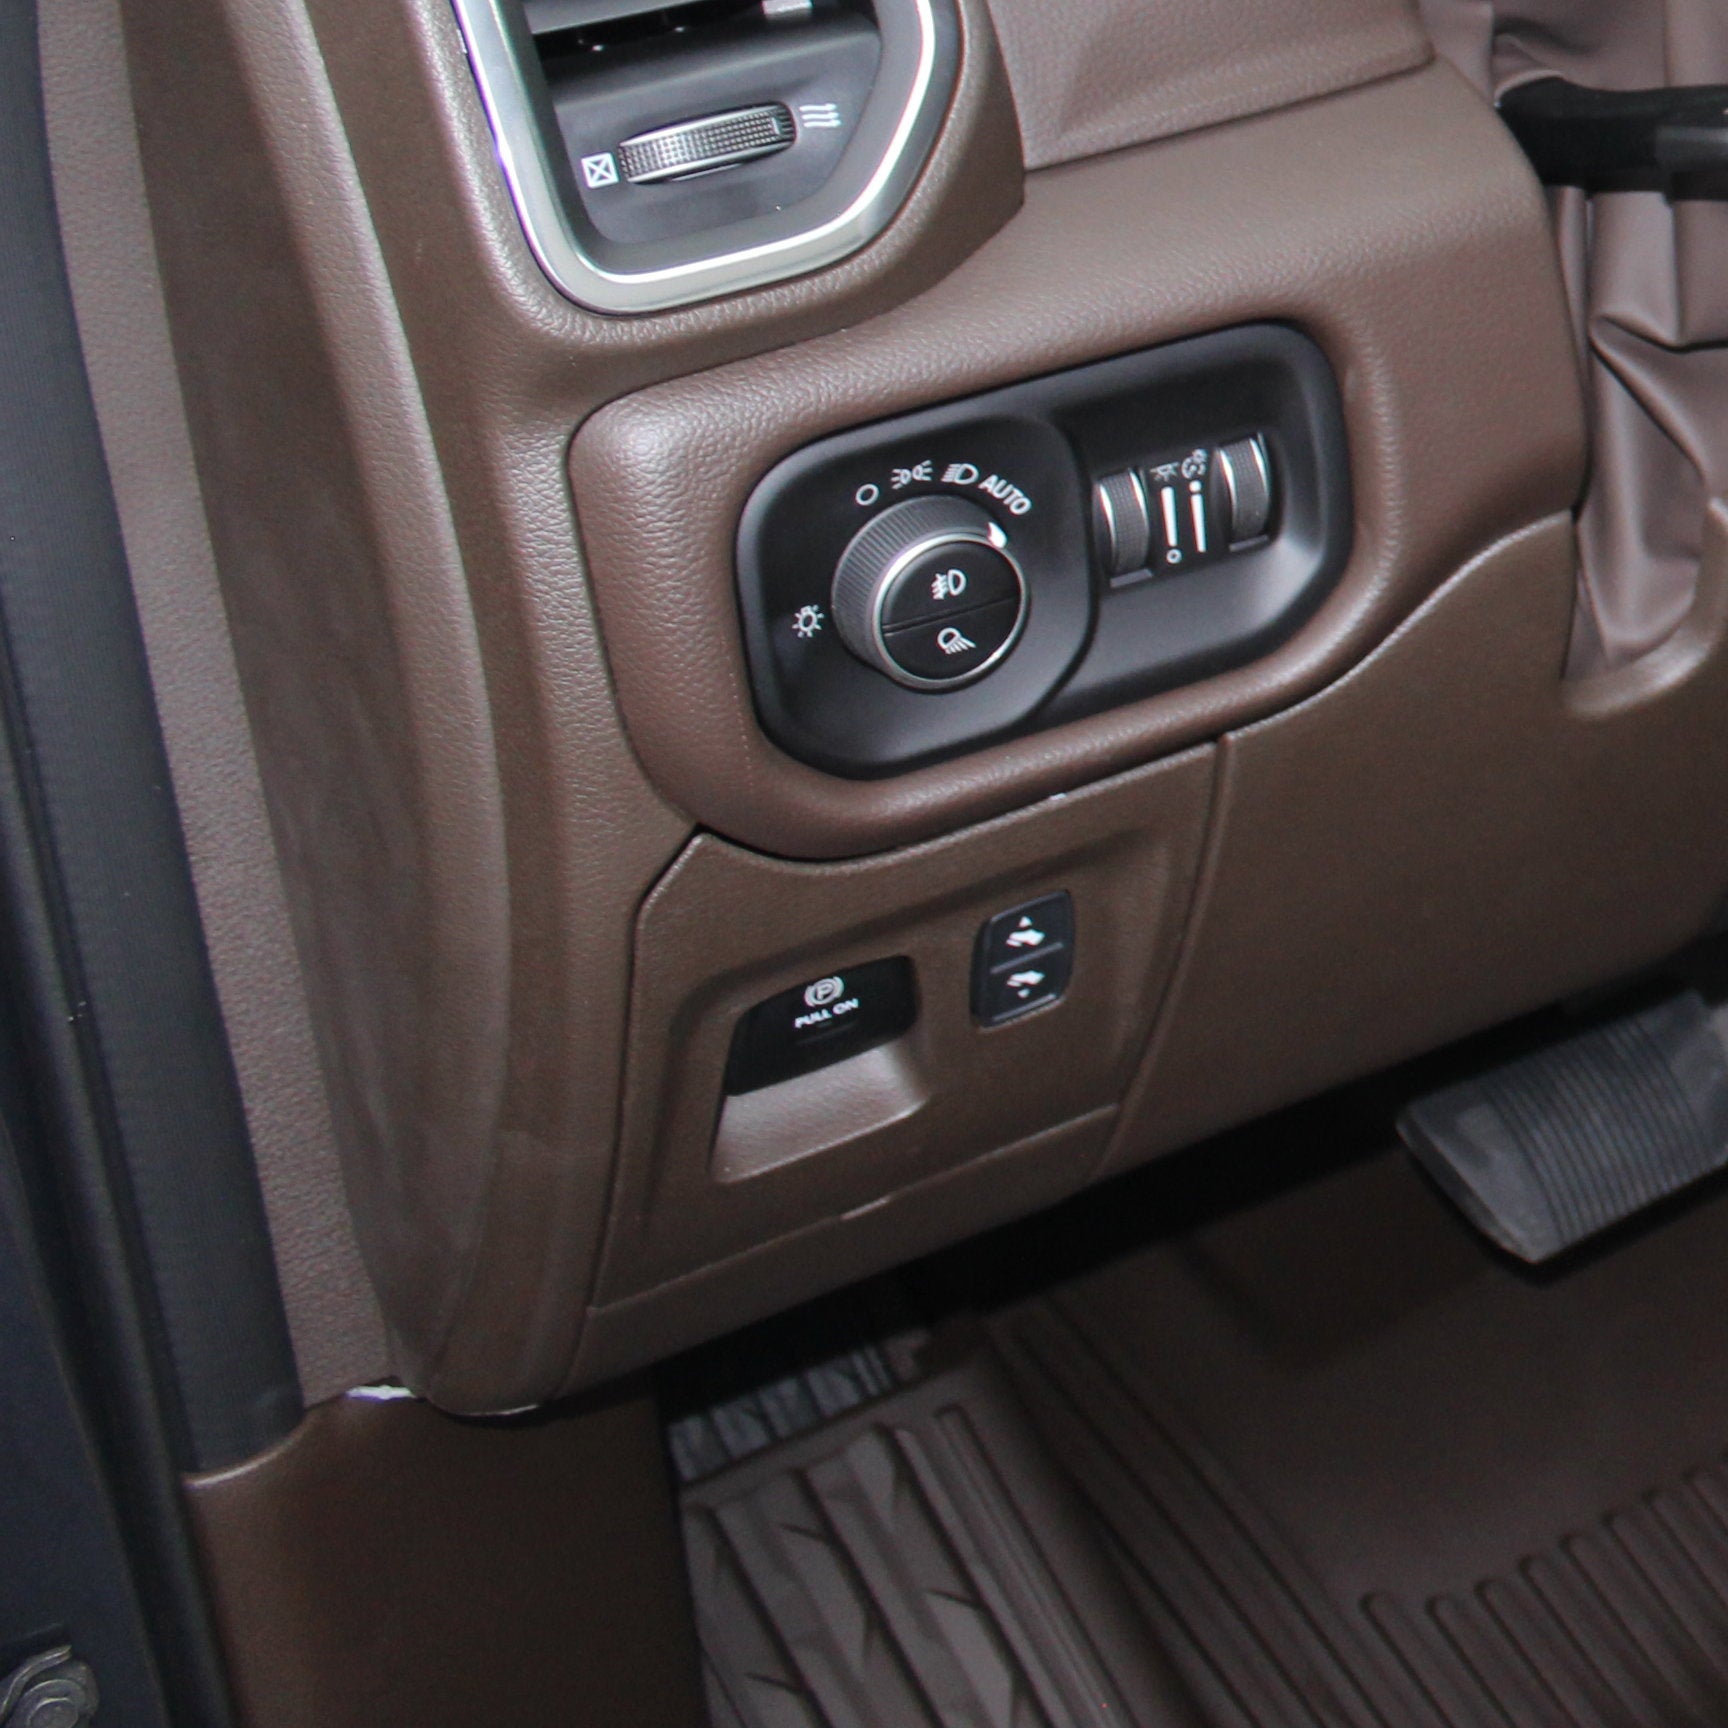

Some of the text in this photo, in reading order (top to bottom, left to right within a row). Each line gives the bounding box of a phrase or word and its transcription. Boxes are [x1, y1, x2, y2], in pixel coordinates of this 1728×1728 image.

[979, 475, 1031, 514] AUTO
[795, 999, 858, 1028] PULL ON
